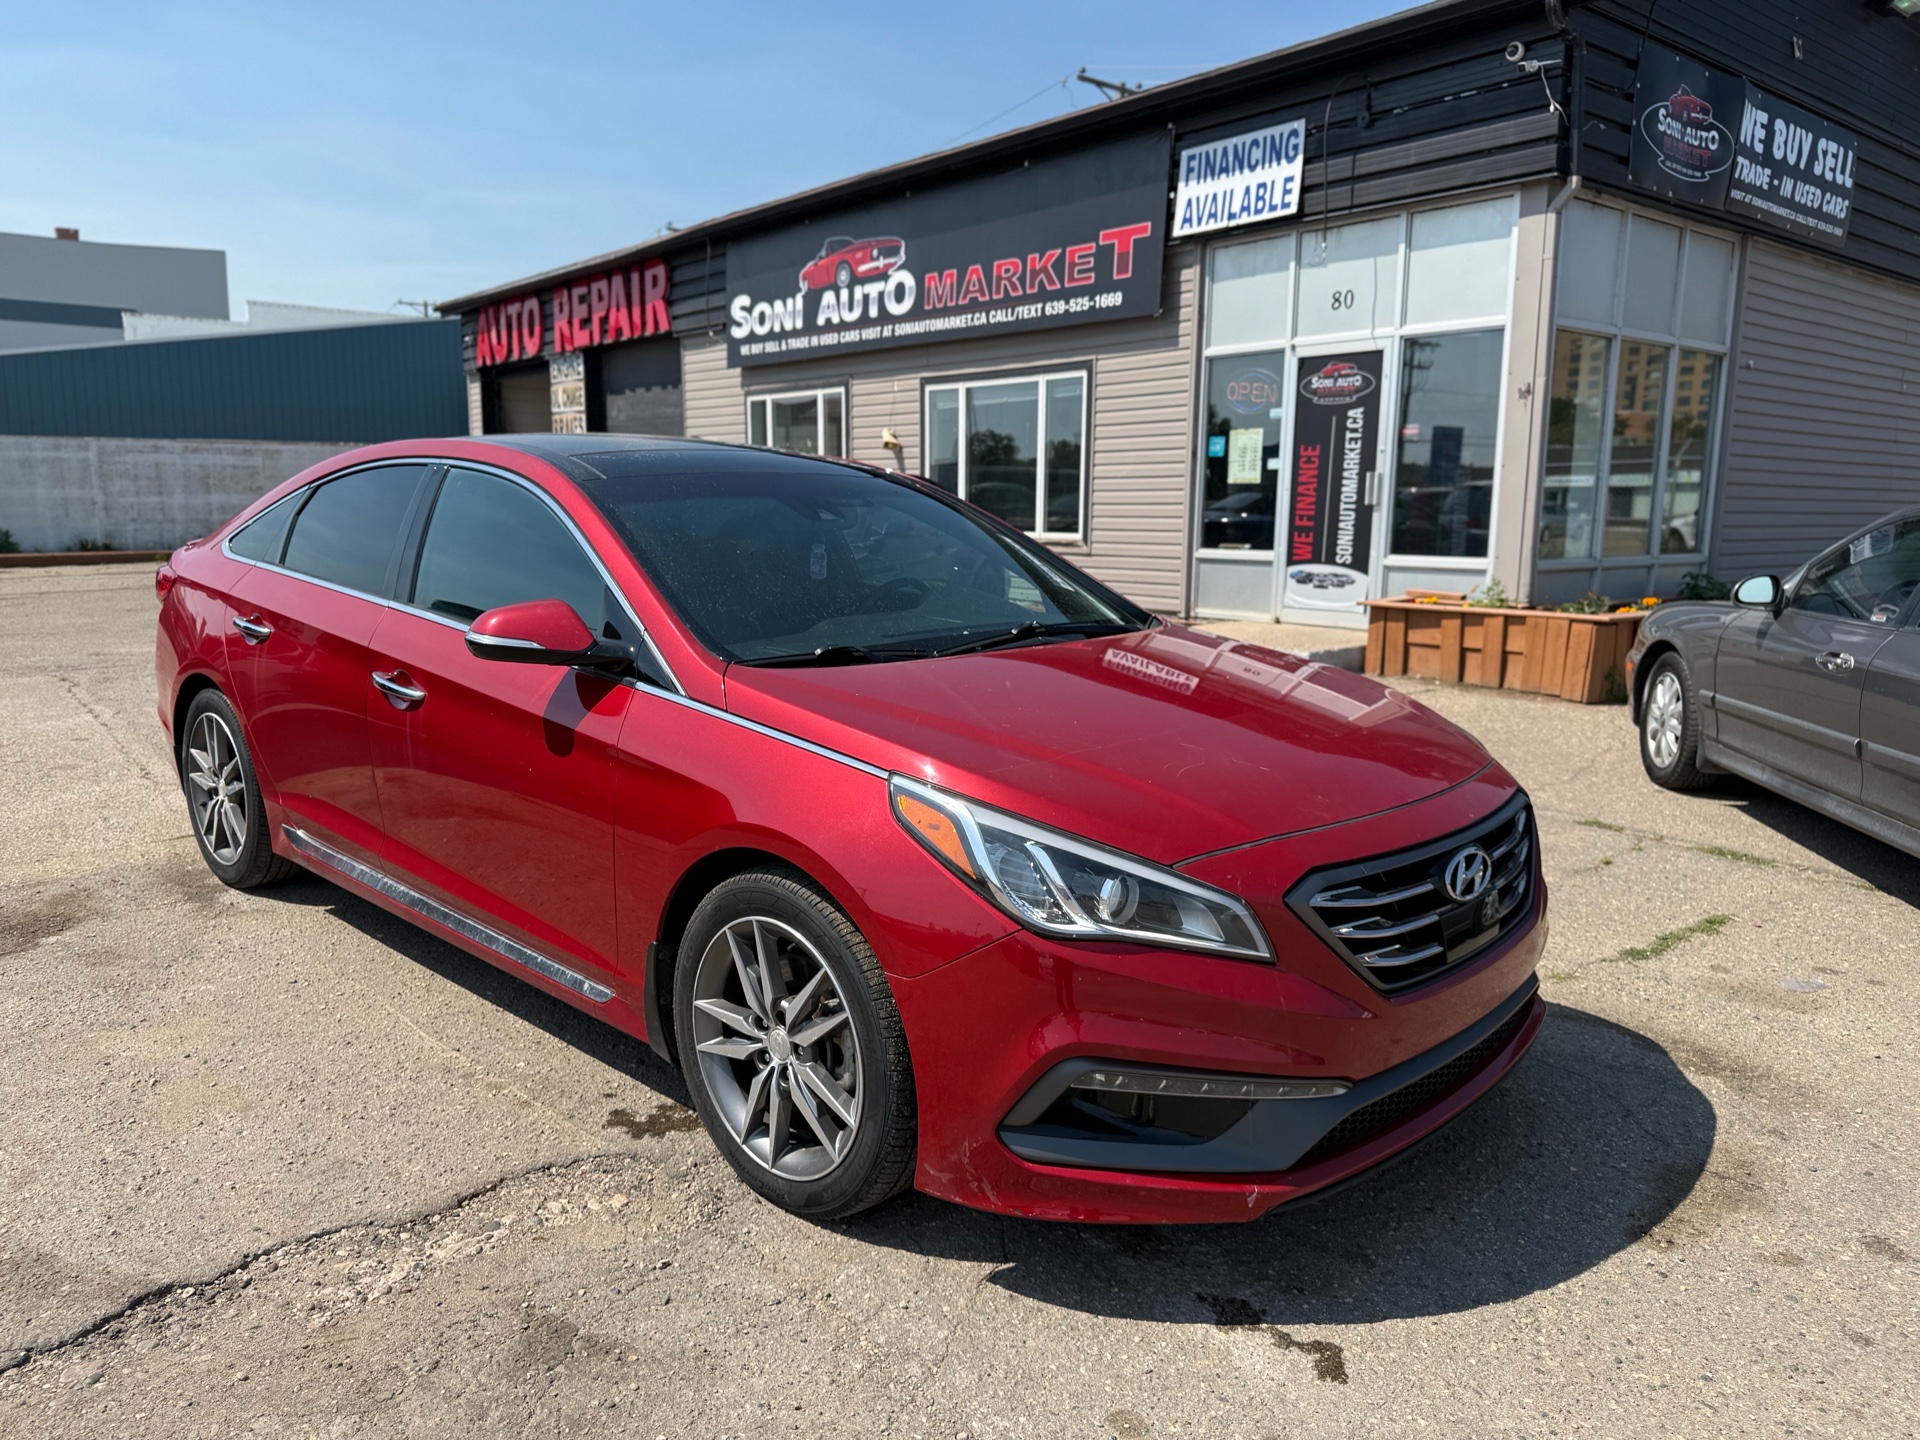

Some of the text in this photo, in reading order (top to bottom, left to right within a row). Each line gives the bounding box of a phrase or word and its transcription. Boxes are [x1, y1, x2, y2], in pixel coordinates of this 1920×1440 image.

[1185, 128, 1300, 187] FINANCING
[1658, 107, 1719, 151] SONI AUTO
[1663, 135, 1711, 168] MARKET
[1740, 98, 1853, 189] WE BUY SELL
[1180, 175, 1295, 230] AVAILABLE
[1730, 188, 1746, 202] VISIT
[1744, 194, 1753, 204] AT
[1734, 155, 1772, 190] TRADE
[1780, 175, 1794, 199] IN
[1794, 181, 1822, 209] USED
[1822, 192, 1849, 219] CARS
[730, 221, 1152, 340] SONI AUTO MARKET
[1330, 289, 1354, 310] 80
[476, 257, 673, 367] AUTO REPAIR
[740, 291, 1123, 356] WE BUY SELL & TRADE IN USED CARS VISIT AT SONIAUTOMARKET.CA CALL/TEXT 639-525-1669
[1226, 381, 1278, 404] OPEN
[1311, 375, 1363, 389] SONI AUTO
[1292, 444, 1320, 561] WE FINANCE
[1335, 406, 1365, 565] SONIAUTOMARKET.CA
